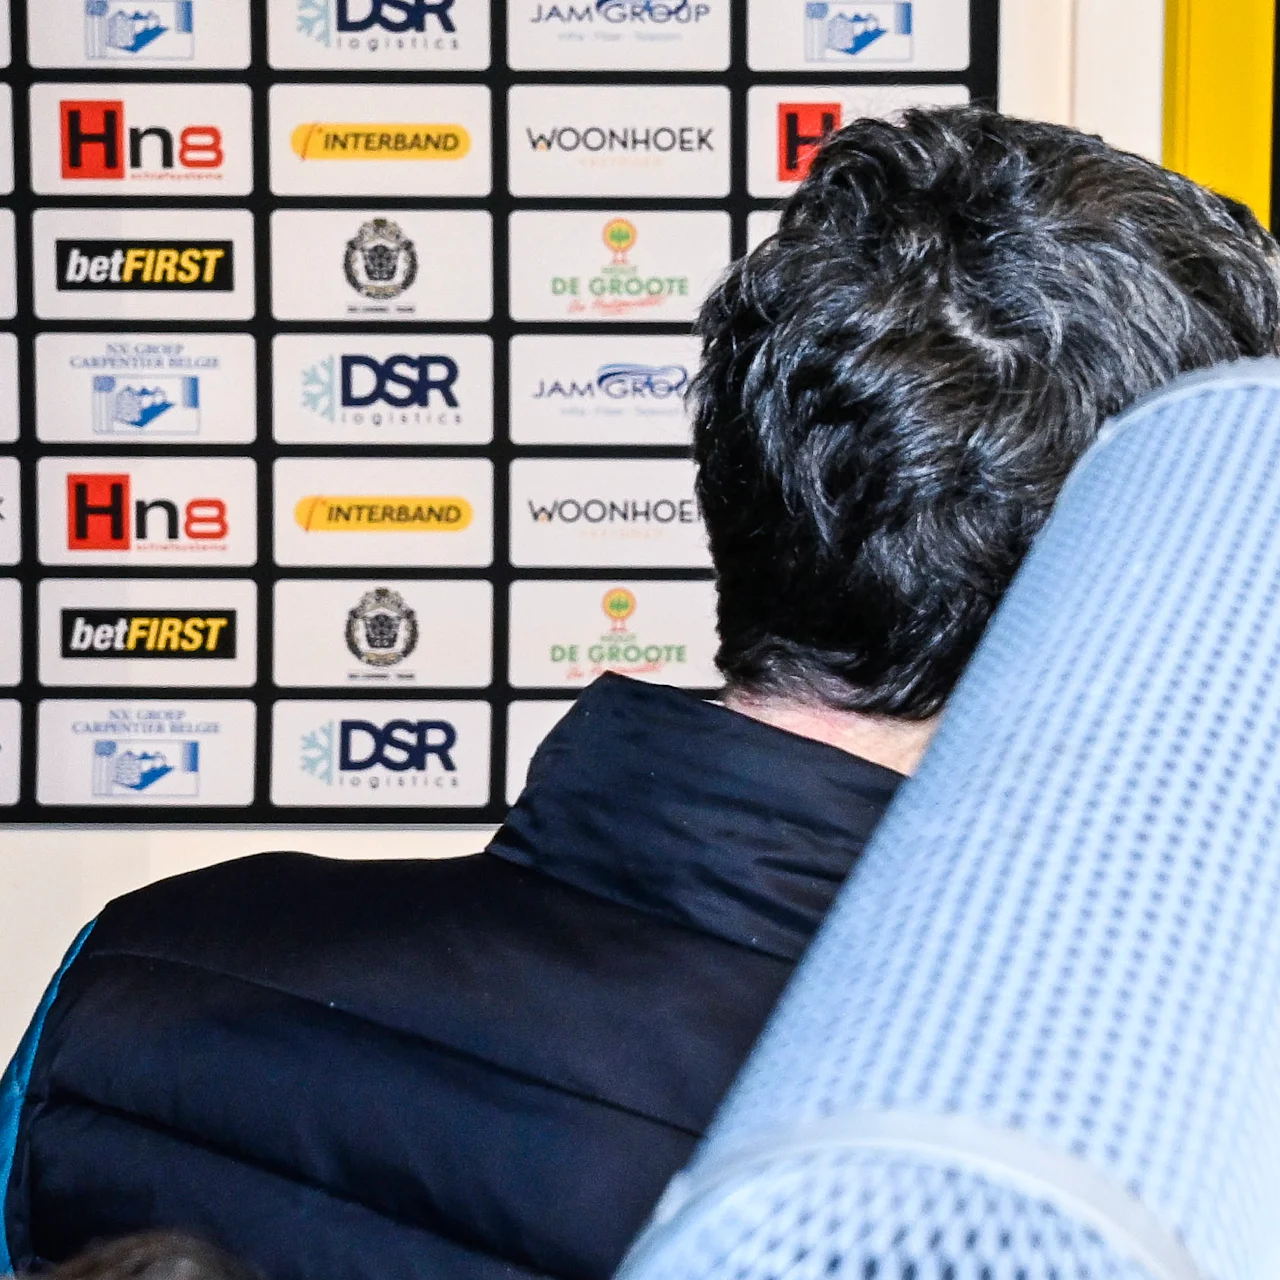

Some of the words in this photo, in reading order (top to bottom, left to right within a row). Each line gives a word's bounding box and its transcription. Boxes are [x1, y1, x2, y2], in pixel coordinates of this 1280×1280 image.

[336, 0, 457, 33] DSR
[530, 3, 595, 24] JAM
[602, 3, 711, 24] GROUP
[336, 37, 461, 52] logistics
[67, 109, 225, 170] Hn8
[323, 132, 460, 152] INTERBAND
[526, 126, 715, 152] WOONHOEK
[65, 247, 225, 285] betFIRST
[551, 276, 580, 296] DE
[588, 276, 690, 297] GROOTE
[340, 354, 460, 408] DSR
[532, 378, 596, 399] JAM
[340, 413, 464, 427] logistics
[75, 483, 229, 540] Hn8
[326, 504, 462, 524] INTERBAND
[70, 617, 227, 652] betFIRST
[550, 644, 579, 662] DE
[587, 644, 687, 663] GROOTE
[339, 719, 457, 772] DSR
[339, 774, 460, 789] logistics
